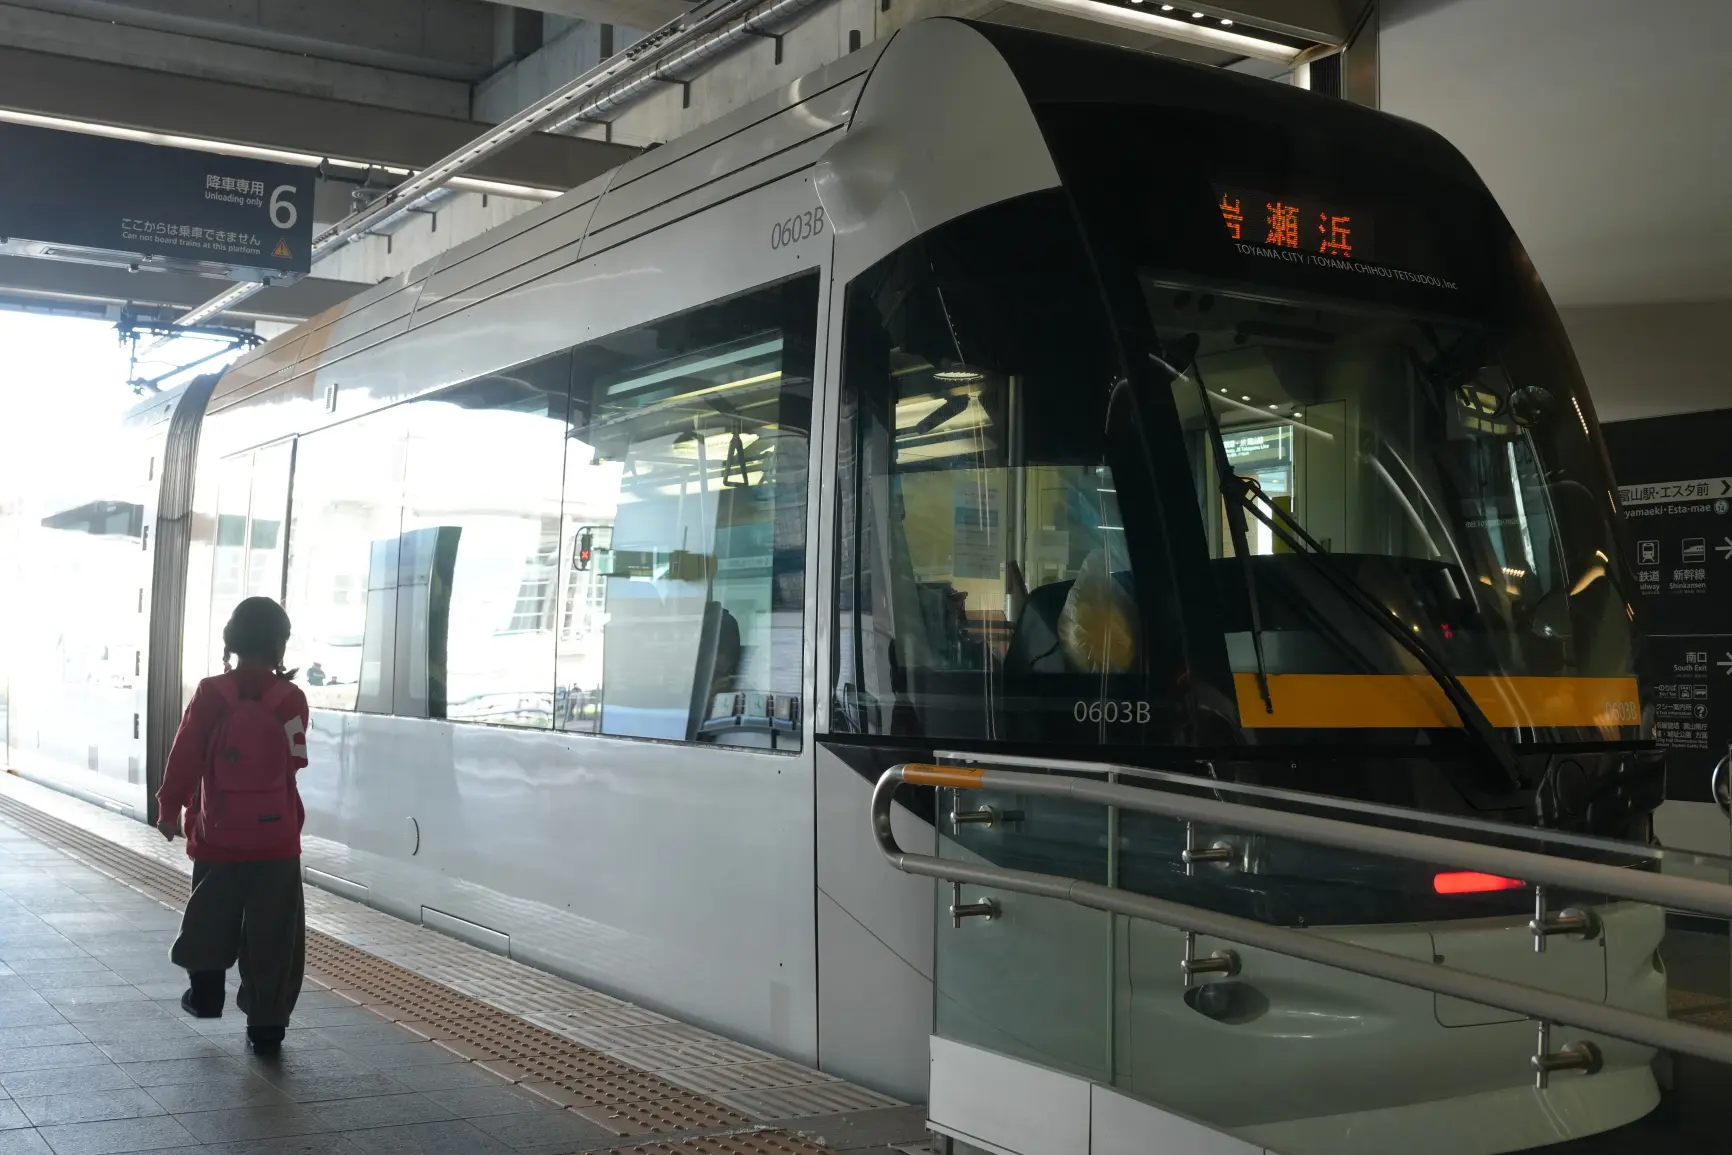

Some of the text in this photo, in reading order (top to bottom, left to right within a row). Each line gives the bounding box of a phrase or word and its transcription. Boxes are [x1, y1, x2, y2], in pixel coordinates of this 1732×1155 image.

[205, 174, 265, 197] 降車専用
[205, 190, 263, 209] Unloading only
[269, 184, 298, 229] 6
[121, 217, 261, 247] ここからは乗車できません
[771, 205, 825, 250] 0603B
[122, 231, 261, 255] Can not board trains at this platform
[1234, 243, 1281, 260] TOYAMA
[1281, 250, 1305, 264] CITY
[1310, 255, 1353, 271] TOYAMA
[1354, 262, 1393, 278] CHIHOU
[1637, 569, 1660, 582] 鉄道
[1669, 581, 1706, 590] Shinkansen
[1673, 568, 1706, 581] 新幹線
[1673, 664, 1707, 672] South Exit
[1685, 651, 1707, 663] 南口
[1074, 700, 1151, 724] 0603B
